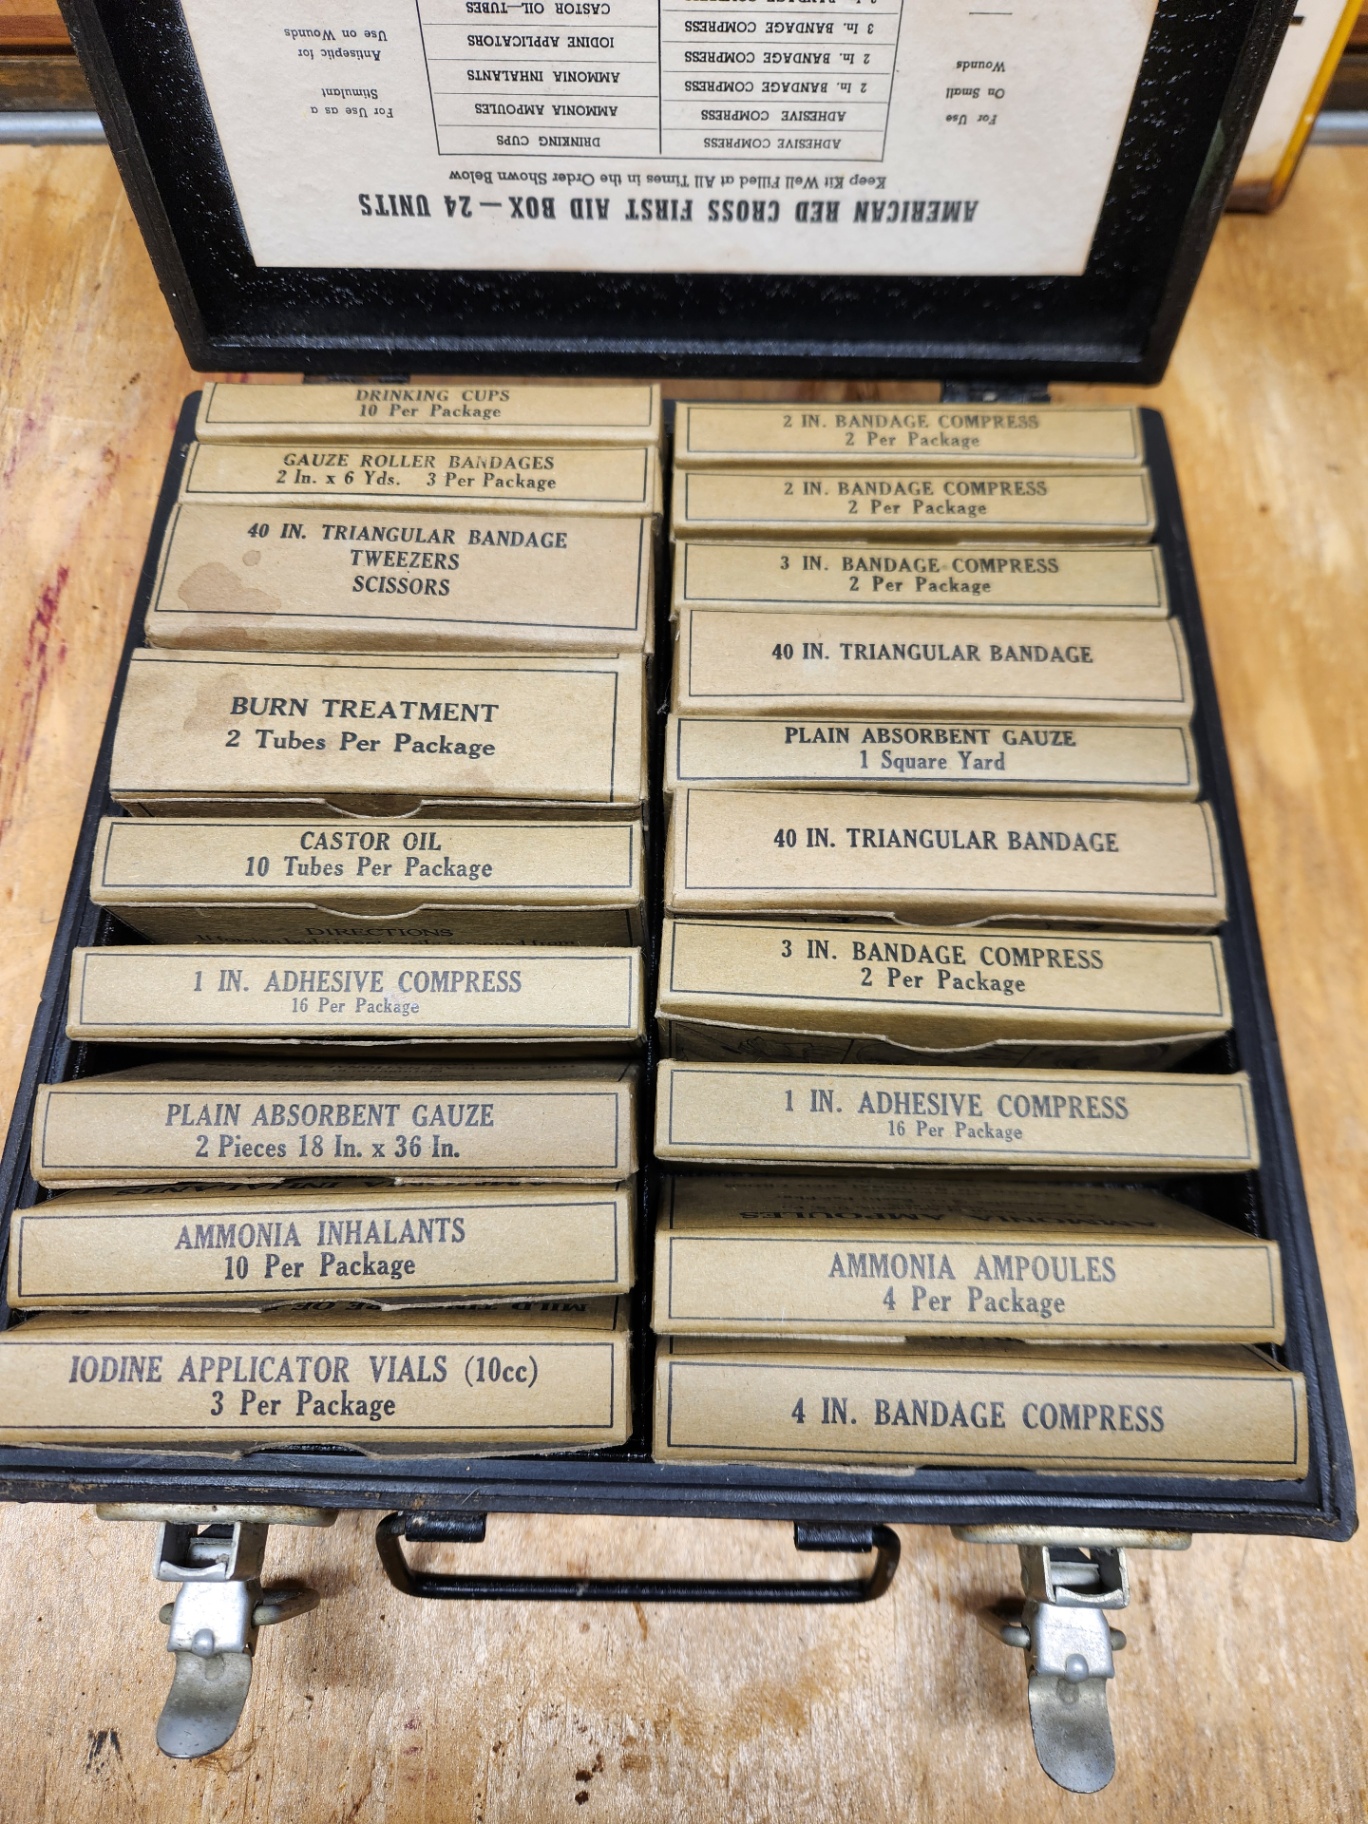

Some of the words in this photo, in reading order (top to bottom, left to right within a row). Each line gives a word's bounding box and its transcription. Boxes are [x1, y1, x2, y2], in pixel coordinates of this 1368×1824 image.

[554, 2, 612, 16] CASTOR
[341, 29, 358, 39] on
[684, 20, 757, 34] COMPRESS
[765, 21, 835, 35] BANDAGE
[843, 22, 859, 35] In.
[867, 23, 875, 36] 3
[283, 28, 337, 42] Wounds
[364, 29, 389, 43] Use
[467, 34, 561, 49] APPLICATORS
[567, 36, 615, 49] IODINE
[298, 48, 315, 61] for
[320, 47, 382, 62] Antiseptic
[684, 51, 756, 64] COMPRESS
[763, 52, 832, 65] BANDAGE
[839, 53, 856, 65] In.
[863, 53, 871, 66] 2
[956, 60, 1006, 73] Wounds
[466, 69, 544, 83] INHALANTS
[552, 70, 621, 84] AMMONIA
[684, 80, 755, 93] COMPRESS
[761, 81, 829, 94] BANDAGE
[837, 82, 853, 94] In.
[860, 82, 868, 94] 2
[945, 87, 981, 100] Small
[321, 88, 379, 101] Stimulant
[987, 88, 1006, 100] On
[310, 106, 319, 115] a
[324, 106, 340, 115] as
[345, 107, 369, 119] Use
[373, 107, 395, 119] For
[474, 103, 545, 116] AMPOULES
[551, 104, 619, 118] AMMONIA
[700, 109, 771, 122] COMPRESS
[781, 110, 848, 123] ADHESIVE
[945, 114, 968, 126] Use
[977, 114, 998, 126] For
[496, 134, 530, 147] CUPS
[538, 135, 601, 148] DRINKING
[703, 137, 772, 150] COMPRESS
[777, 138, 842, 150] ADHESIVE
[448, 170, 494, 185] Below
[496, 171, 548, 186] Shown
[552, 172, 596, 187] Order
[599, 173, 623, 188] the
[627, 174, 642, 187] in
[646, 174, 690, 189] Times
[694, 174, 717, 189] All
[720, 175, 735, 188] at
[739, 175, 781, 190] Filled
[785, 175, 820, 190] Well
[824, 175, 845, 190] Kit
[849, 173, 887, 190] Keep
[358, 193, 432, 218] UNITS
[443, 195, 473, 219] 24
[508, 196, 556, 220] BOX
[570, 197, 611, 221] AID
[625, 198, 694, 222] FIRST
[708, 199, 781, 223] CROSS
[795, 201, 841, 223] RED
[853, 200, 979, 223] AMERICAN
[356, 389, 449, 402] DRINKING
[461, 389, 511, 402] CUPS
[283, 452, 350, 468] GAUZE
[359, 454, 436, 469] ROLLER
[448, 455, 555, 471] BANDAGES
[275, 469, 288, 484] 2
[293, 468, 317, 485] In.
[325, 474, 337, 485] x
[344, 470, 355, 485] 6
[364, 469, 401, 486] Yds.
[426, 471, 437, 487] 3
[444, 471, 476, 488] Per
[482, 471, 557, 493] Package
[784, 481, 794, 496] 2
[803, 480, 829, 496] IN.
[837, 480, 935, 496] BANDAGE
[943, 480, 1048, 496] COMPRESS
[247, 522, 270, 539] 40
[279, 522, 307, 540] IN.
[321, 523, 456, 545] TRIANGULAR
[467, 529, 568, 549] BANDAGE
[350, 548, 460, 572] TWEEZERS
[780, 555, 790, 571] 3
[802, 555, 829, 571] IN.
[842, 556, 941, 574] BANDAGE
[951, 557, 1060, 574] COMPRESS
[352, 575, 451, 597] SCISSORS
[771, 643, 794, 661] 40
[802, 642, 830, 660] IN.
[839, 642, 981, 662] TRIANGULAR
[989, 644, 1094, 664] BANDAGE
[229, 696, 310, 717] BURN
[321, 698, 500, 723] TREATMENT
[784, 726, 850, 745] PLAIN
[861, 727, 992, 746] ABSORBENT
[1001, 729, 1077, 747] GAUZE
[224, 729, 242, 748] 2
[255, 728, 327, 751] Tubes
[338, 731, 382, 753] Per
[393, 732, 496, 760] Package
[300, 830, 391, 852] CASTOR
[402, 831, 442, 852] OIL
[773, 828, 798, 849] 40
[806, 827, 836, 848] IN.
[845, 827, 999, 851] TRIANGULAR
[1007, 830, 1120, 853] BANDAGE
[244, 856, 270, 878] 10
[283, 855, 344, 877] Tubes
[356, 856, 393, 877] Per
[404, 856, 493, 882] Package
[305, 927, 454, 937] DIRECTIONS
[781, 939, 793, 959] 3
[806, 938, 838, 961] IN.
[852, 940, 967, 966] BANDAGE
[979, 945, 1104, 970] COMPRESS
[193, 970, 203, 992] 1
[217, 969, 250, 993] IN.
[263, 969, 384, 993] ADHESIVE
[397, 970, 523, 994] COMPRESS
[785, 1089, 794, 1113] 1
[809, 1088, 843, 1114] IN.
[857, 1090, 984, 1118] ADHESIVE
[997, 1093, 1130, 1121] COMPRESS
[165, 1103, 242, 1127] PLAIN
[251, 1103, 401, 1128] ABSORBENT
[411, 1103, 495, 1128] GAUZE
[195, 1134, 209, 1158] 2
[217, 1134, 287, 1158] Pieces
[298, 1134, 324, 1158] 18
[334, 1134, 363, 1159] In.
[371, 1143, 386, 1159] x
[394, 1134, 422, 1159] 36
[431, 1134, 461, 1159] In.
[739, 1210, 945, 1222] AMPOULES
[968, 1213, 1158, 1228] AMMONIA
[174, 1221, 302, 1251] AMMONIA
[316, 1217, 466, 1247] INHALANTS
[828, 1251, 957, 1281] AMMONIA
[973, 1254, 1117, 1284] AMPOULES
[511, 1301, 589, 1312] MILD
[68, 1355, 163, 1384] IODINE
[177, 1355, 351, 1384] APPLICATOR
[369, 1355, 448, 1384] VIALS
[464, 1355, 539, 1389] (10cc)
[791, 1397, 807, 1425] 4
[820, 1397, 857, 1426] IN.
[874, 1398, 1006, 1430] BANDAGE
[1022, 1402, 1165, 1433] COMPRESS
